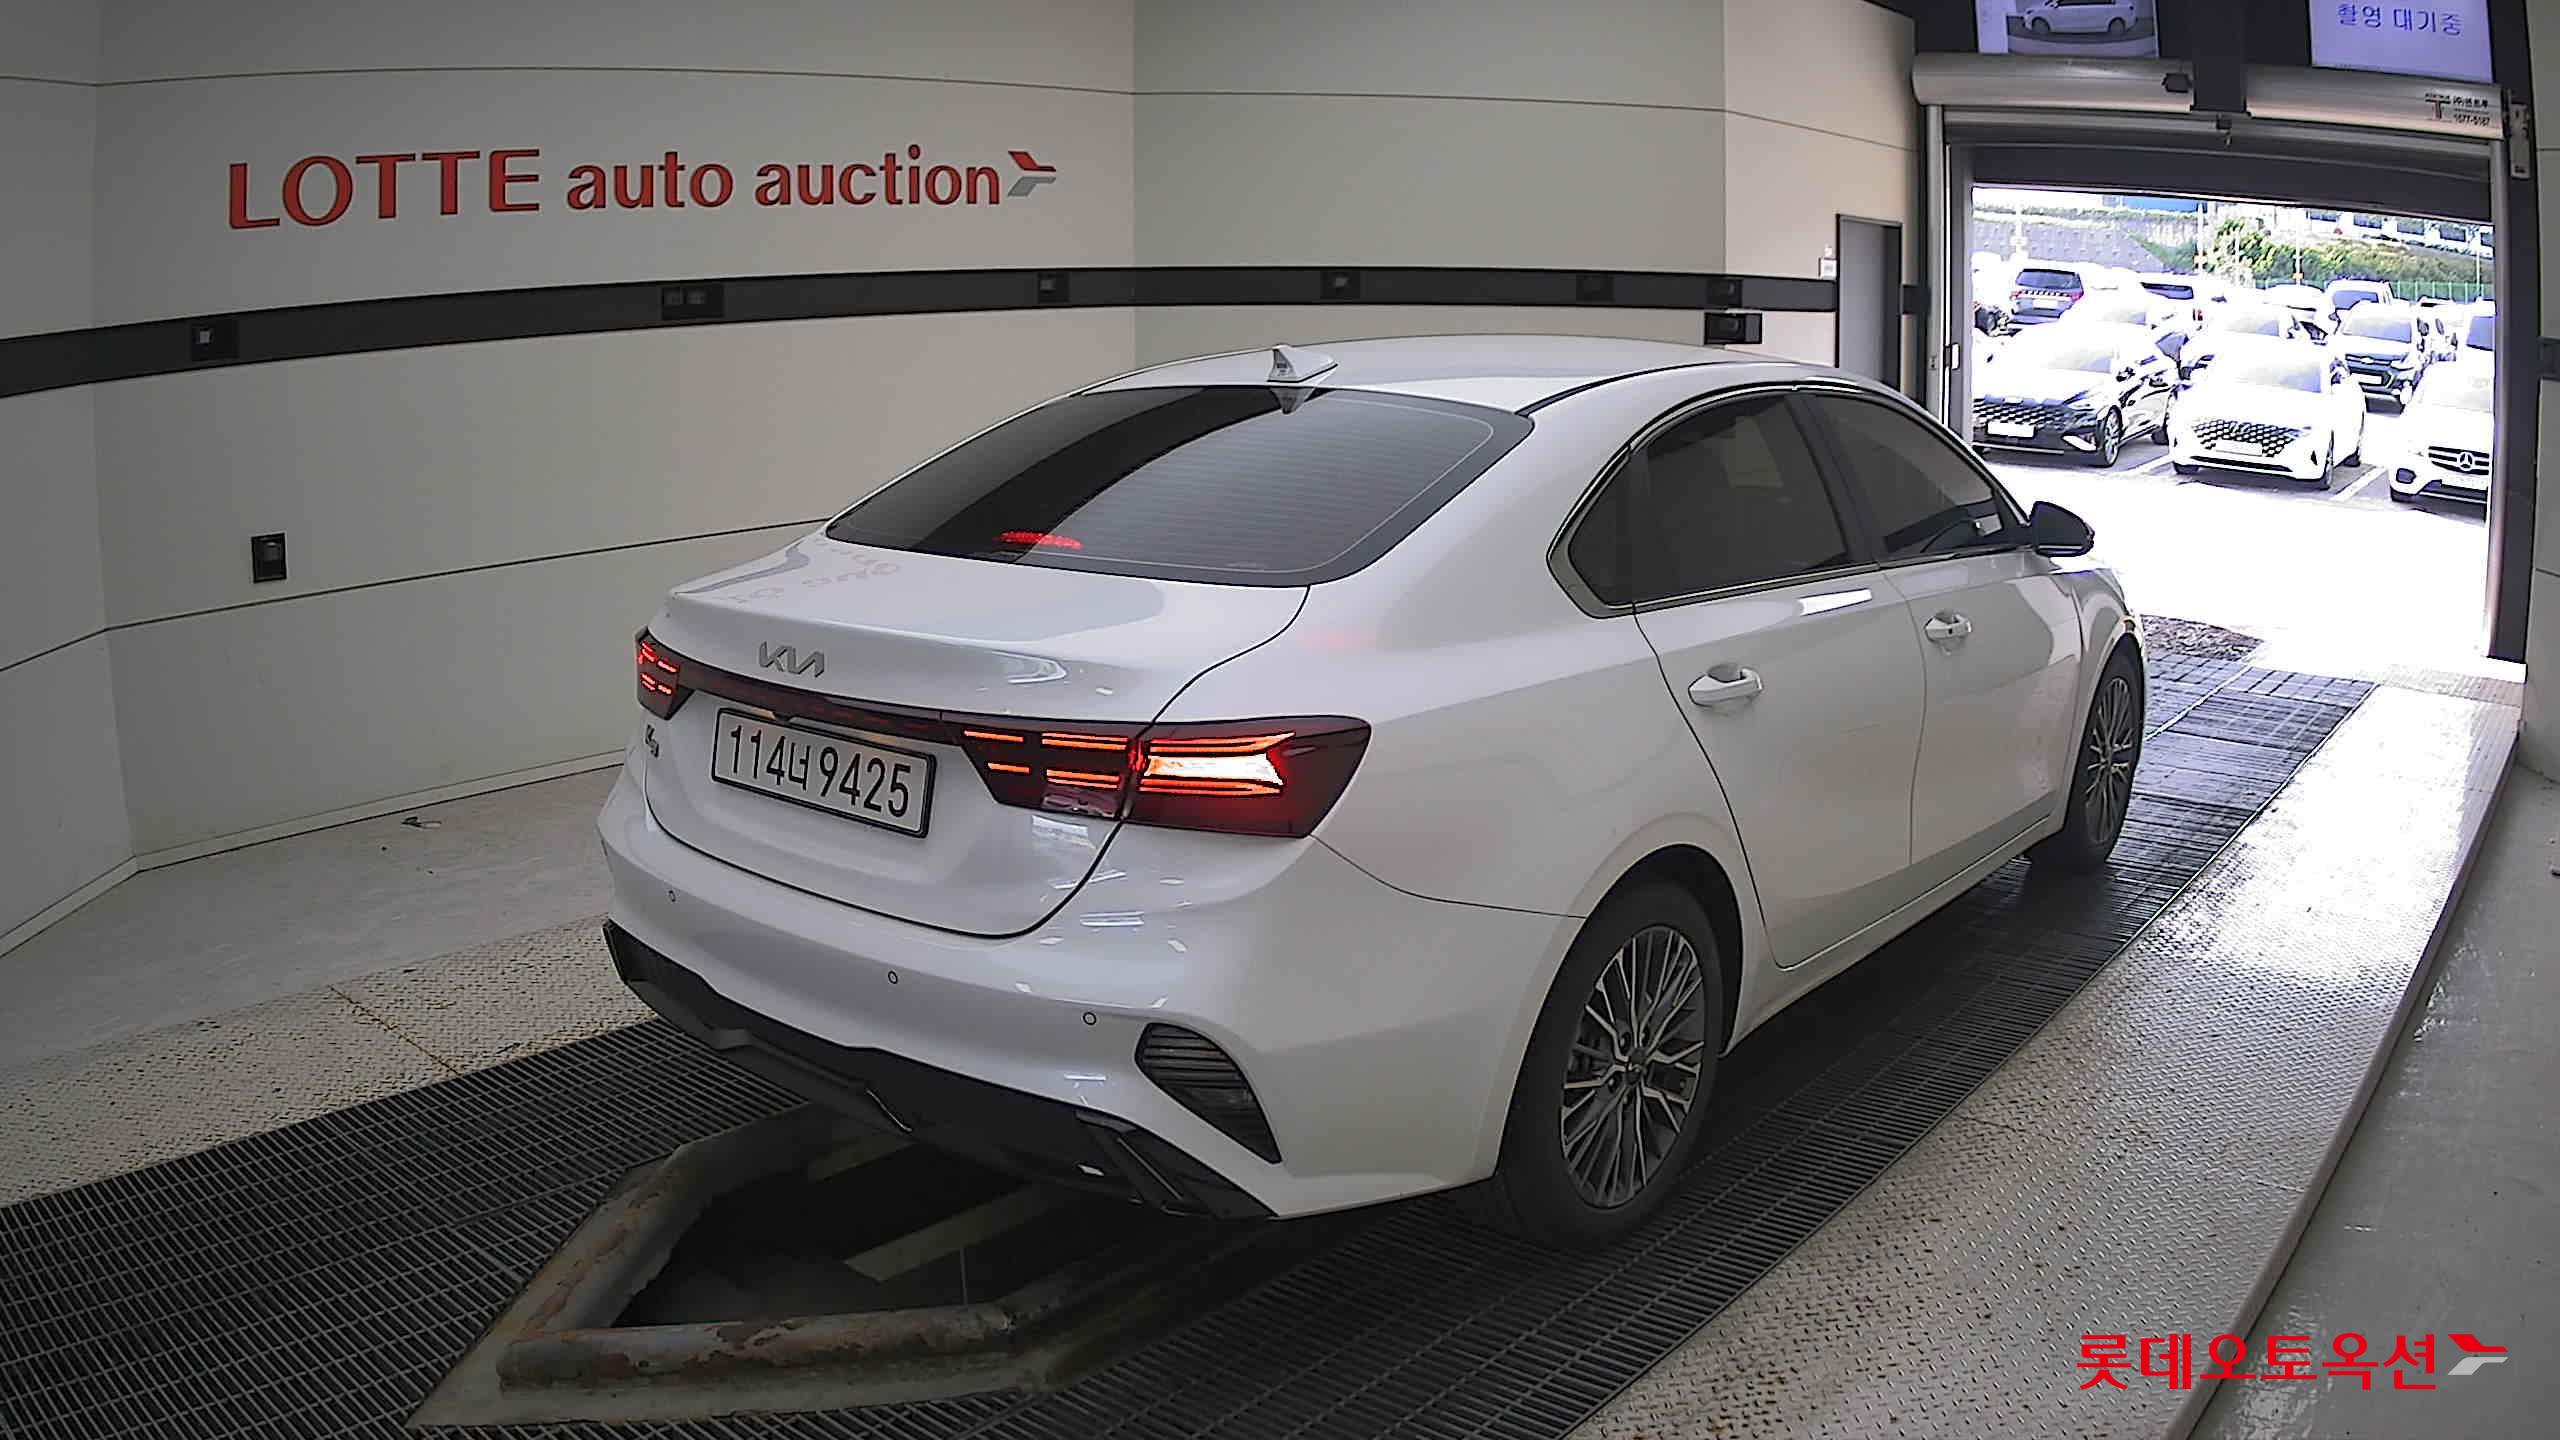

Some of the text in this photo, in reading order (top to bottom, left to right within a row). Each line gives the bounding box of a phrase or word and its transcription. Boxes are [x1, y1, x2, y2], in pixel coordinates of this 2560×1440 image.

[228, 146, 1002, 229] LOTTE auto auction
[759, 641, 825, 677] KIA
